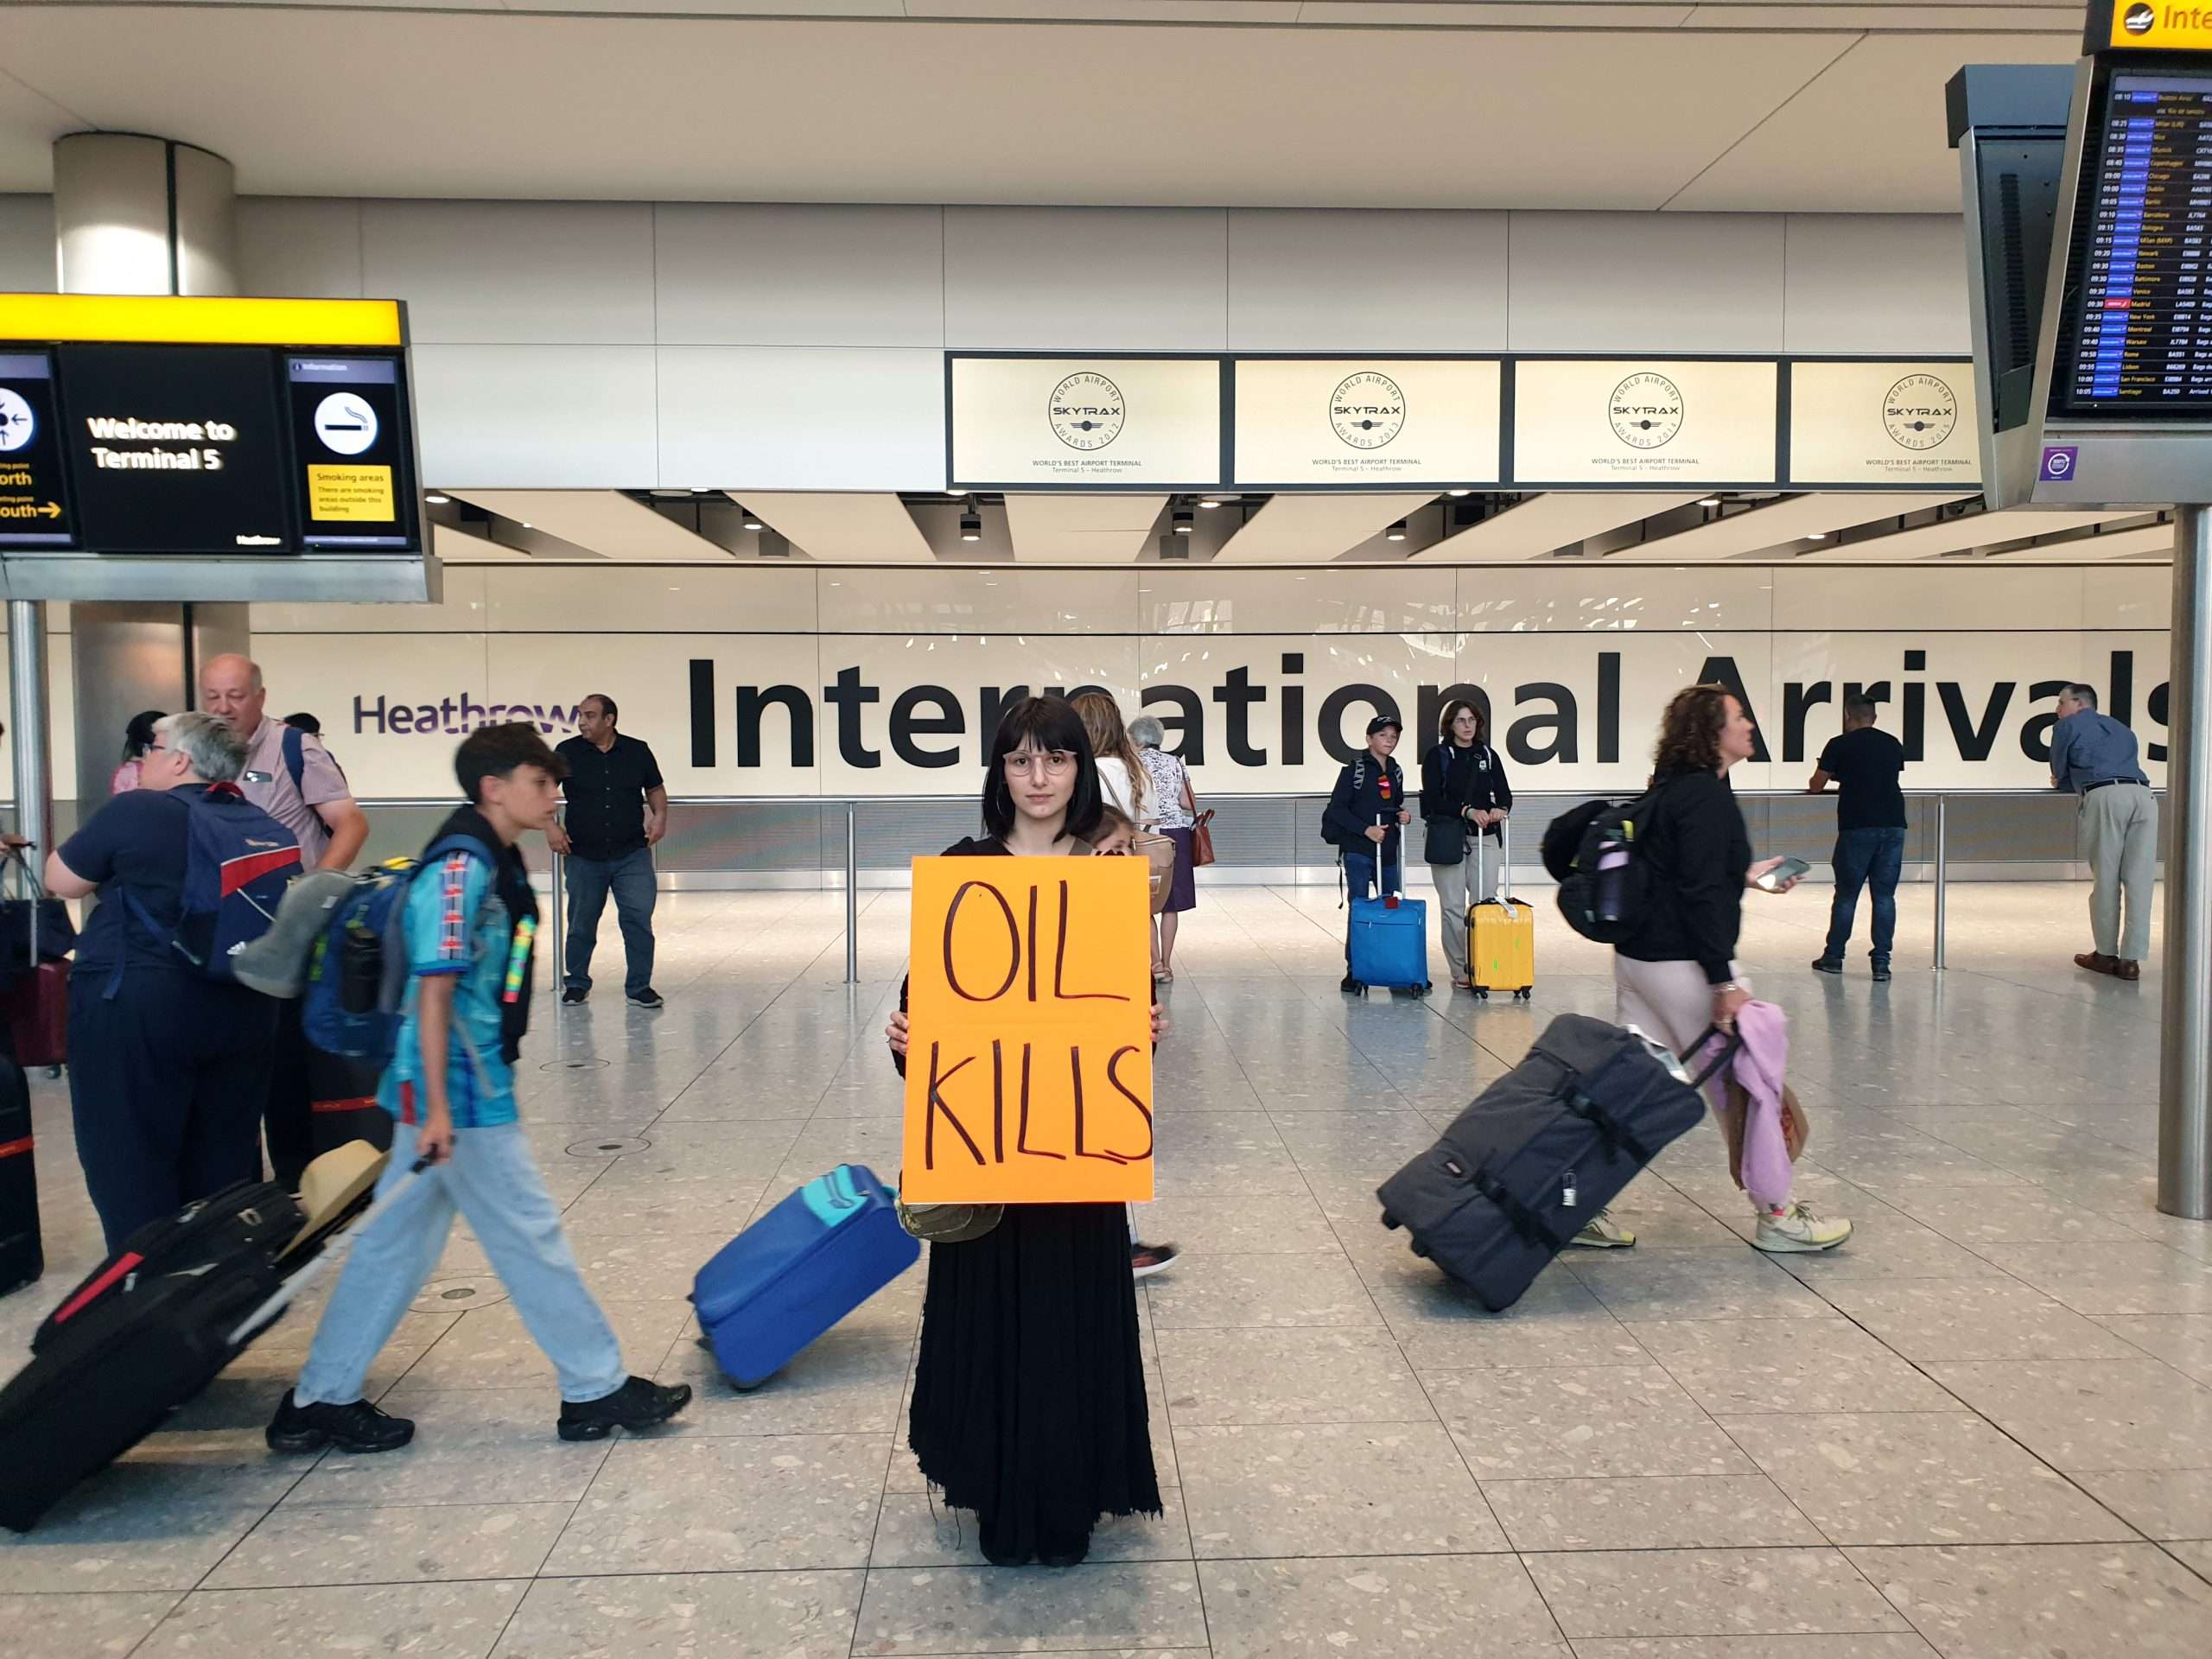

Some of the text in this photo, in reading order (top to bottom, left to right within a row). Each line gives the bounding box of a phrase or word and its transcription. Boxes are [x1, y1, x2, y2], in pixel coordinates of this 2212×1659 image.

[1053, 375, 1120, 403] WORLD AIRPORT
[1335, 375, 1400, 403] WORLD AIRPORT
[1613, 376, 1678, 403] WORLD AIRPORT
[1887, 377, 1952, 404] WORLD AIRPORT
[1334, 406, 1401, 415] SKYTRAX
[1613, 406, 1679, 415] SKYTRAX
[87, 417, 238, 441] Welcome to
[1055, 423, 1119, 448] AWARDS 2012
[1336, 423, 1372, 446] AWARDS
[1614, 423, 1650, 446] AWARDS
[1889, 423, 1924, 447] AWARDS
[91, 447, 224, 470] Terminal 5
[317, 473, 357, 484] Smoking
[353, 691, 580, 734] Heathrow
[690, 652, 1620, 768] Interational
[944, 880, 1130, 1002] OIL
[925, 1039, 1154, 1171] KILLS
